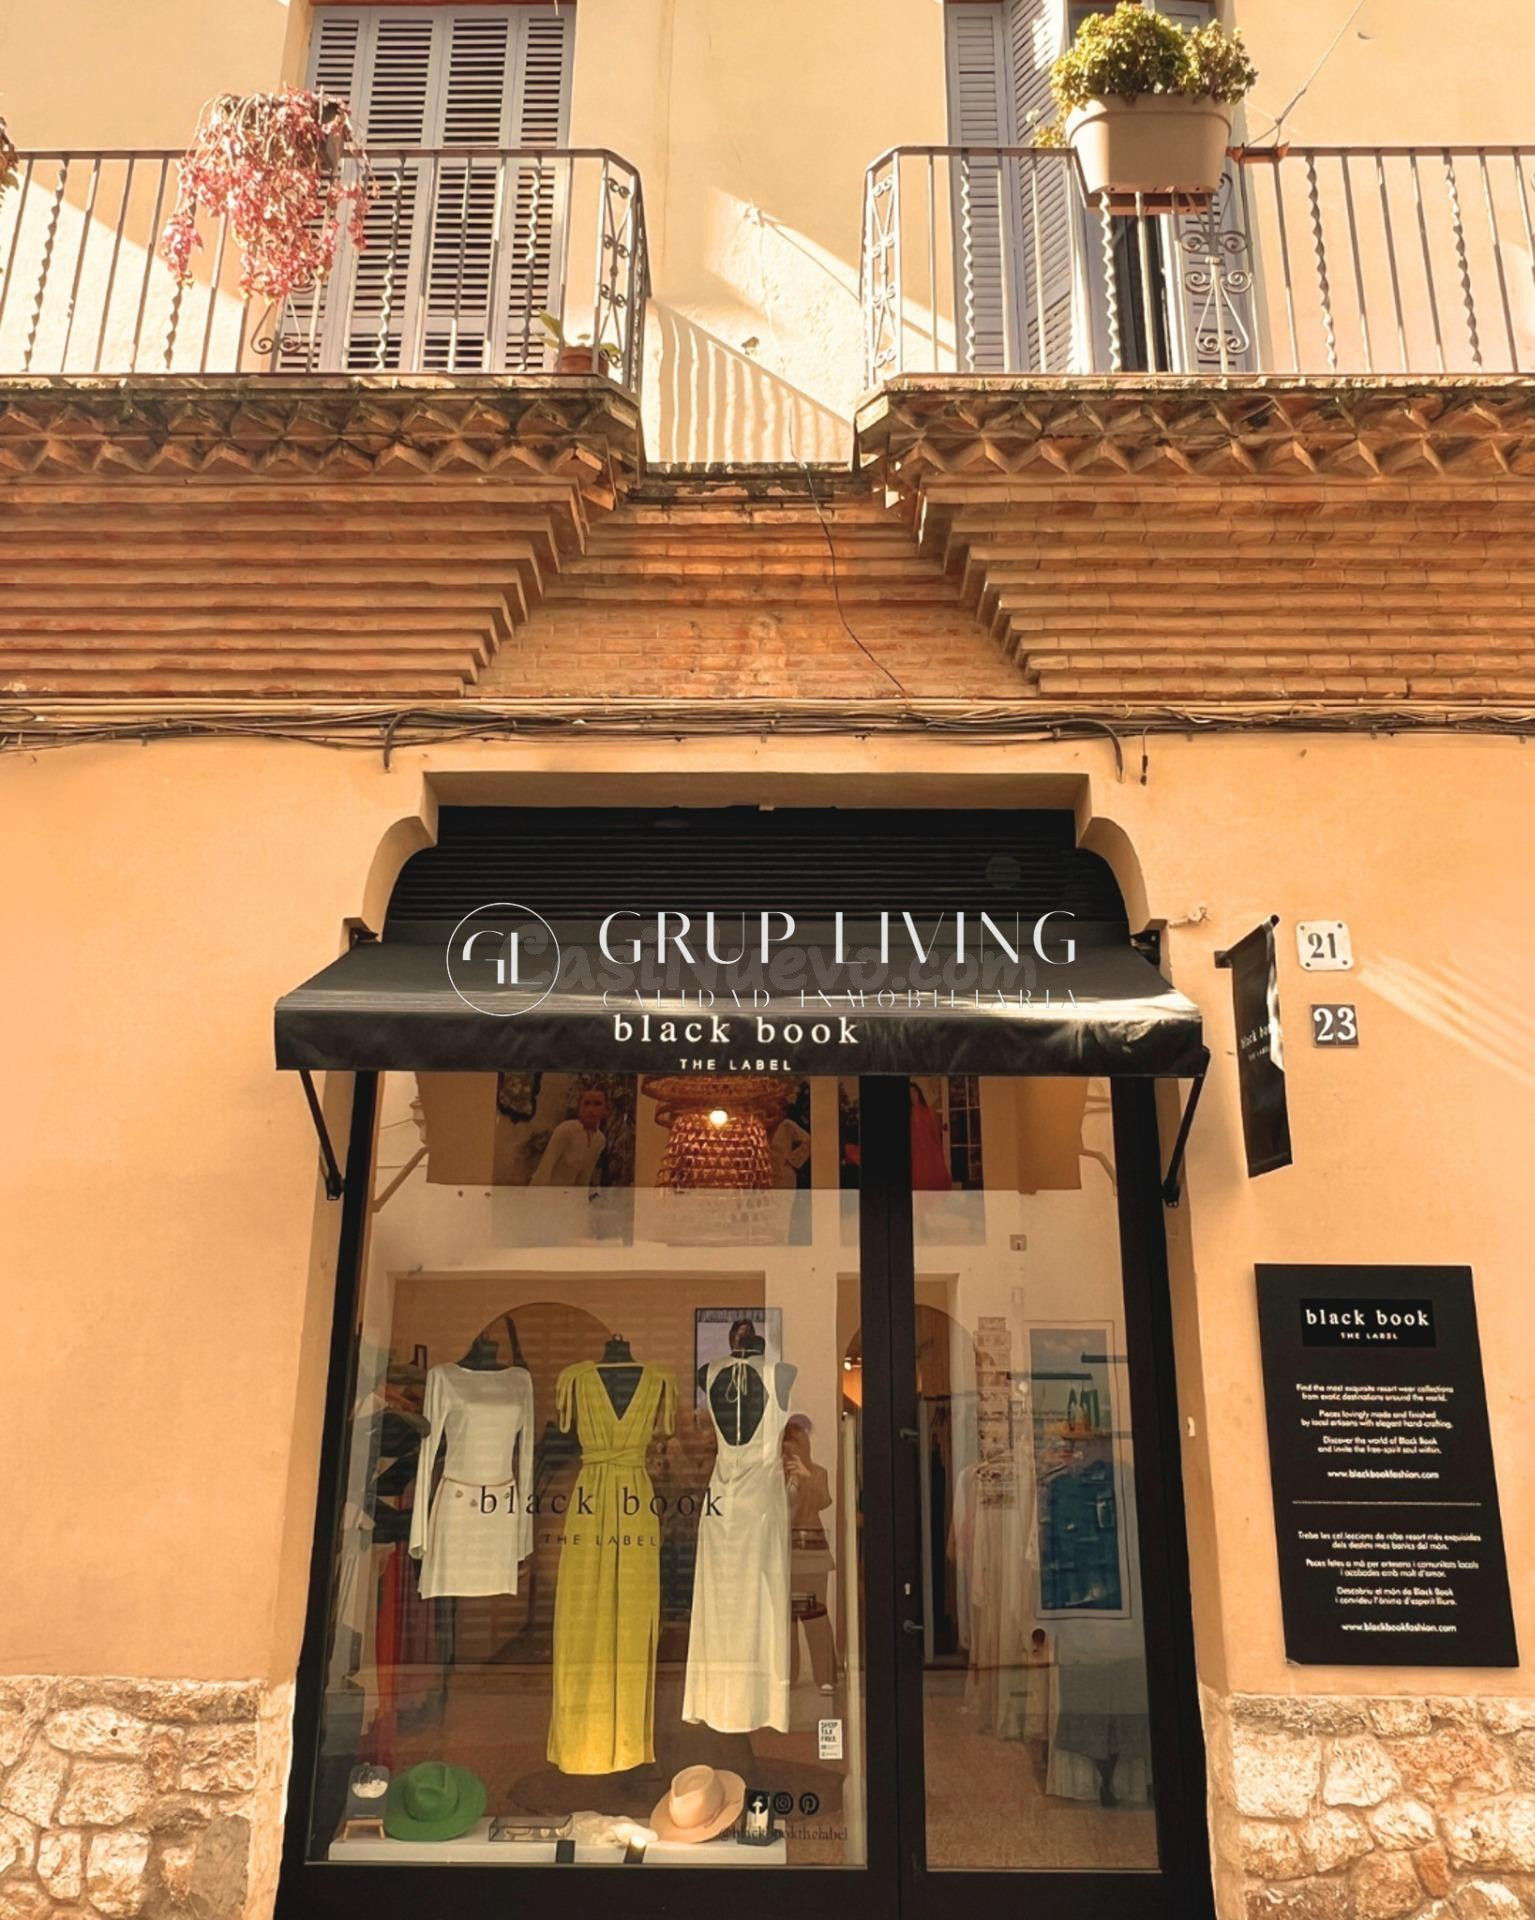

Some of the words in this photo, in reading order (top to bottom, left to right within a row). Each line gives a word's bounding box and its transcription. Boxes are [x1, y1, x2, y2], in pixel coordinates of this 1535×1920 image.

[1307, 932, 1337, 959] 21
[613, 1014, 731, 1044] black
[756, 1015, 860, 1046] book
[1313, 1007, 1357, 1042] 23
[680, 1058, 717, 1071] THE
[728, 1058, 793, 1072] LABEL
[1304, 1308, 1366, 1326] black
[1375, 1309, 1431, 1327] book
[1339, 1331, 1361, 1341] THE
[1365, 1331, 1399, 1341] LABEL
[480, 1485, 594, 1514] black
[622, 1487, 724, 1517] book
[541, 1533, 581, 1546] THE
[595, 1534, 657, 1547] LABEL
[719, 1825, 848, 1841] @blackookthelabel
